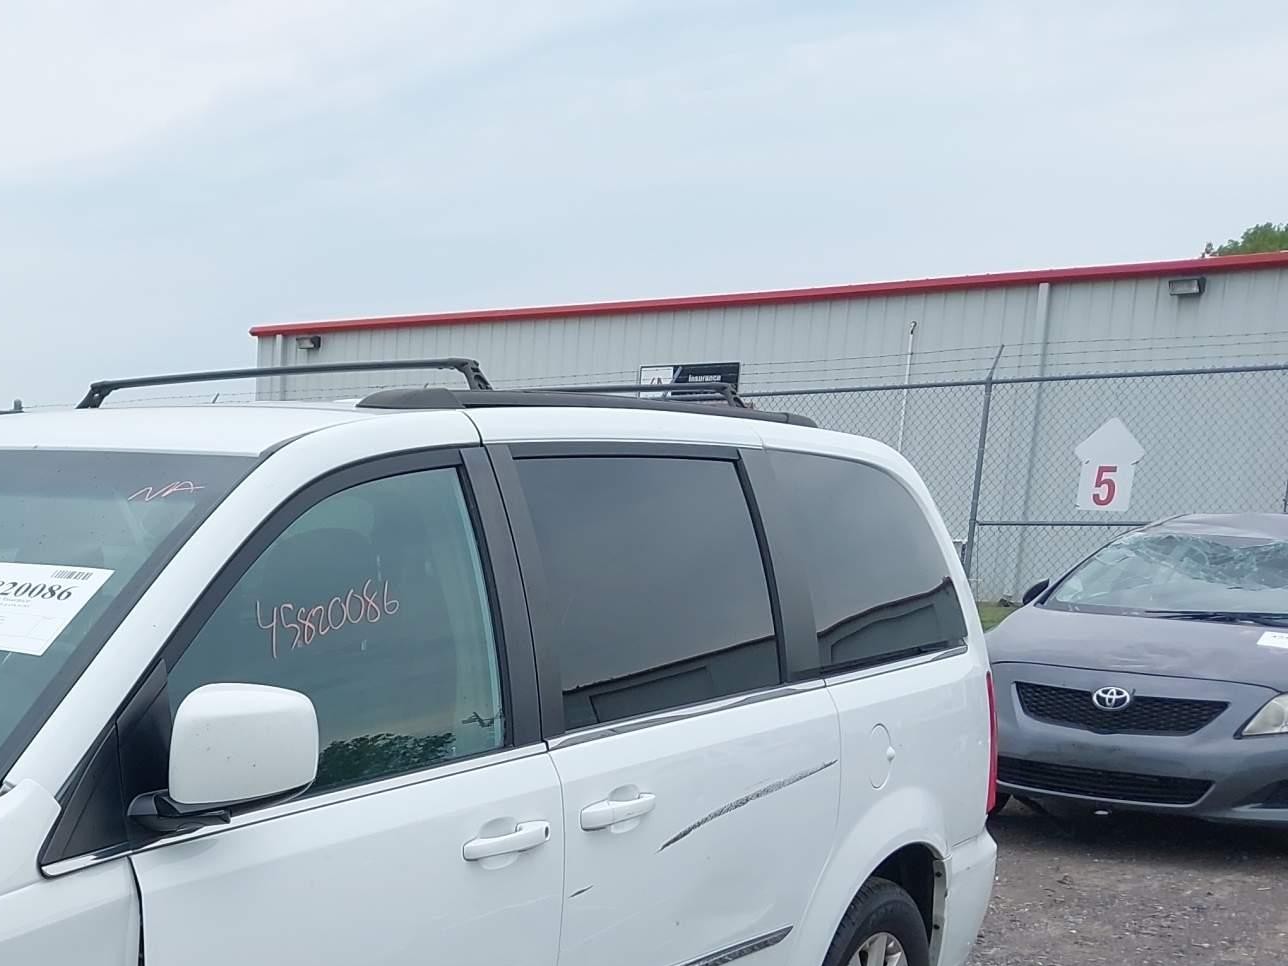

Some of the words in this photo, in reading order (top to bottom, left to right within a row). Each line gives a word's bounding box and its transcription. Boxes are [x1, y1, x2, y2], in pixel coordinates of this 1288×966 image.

[688, 374, 721, 382] Insurance
[1092, 466, 1117, 506] 5
[256, 579, 400, 658] 45820086
